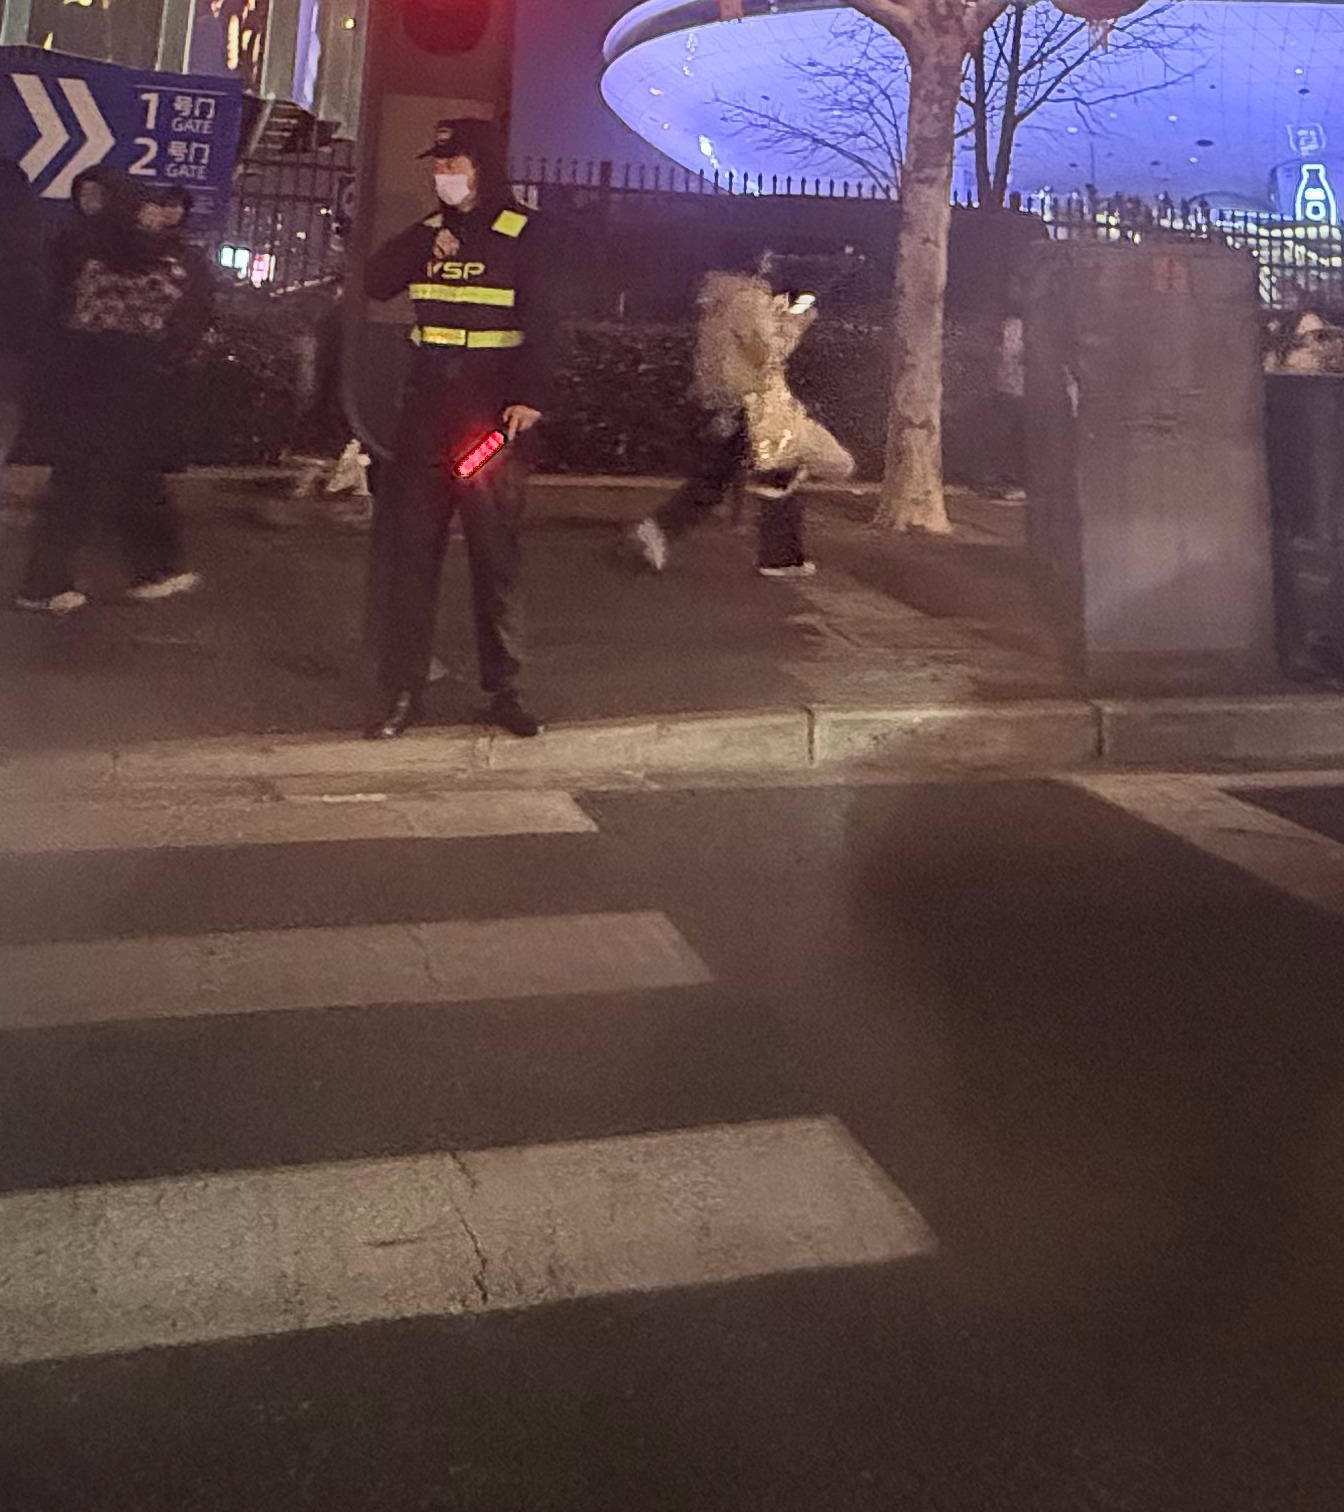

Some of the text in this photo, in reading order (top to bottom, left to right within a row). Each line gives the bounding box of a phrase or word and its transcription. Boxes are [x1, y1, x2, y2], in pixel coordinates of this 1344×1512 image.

[139, 92, 160, 131] 1
[172, 95, 215, 121] 号门
[171, 119, 214, 135] GATE
[127, 137, 159, 176] 2
[167, 140, 211, 166] 号门
[165, 163, 208, 180] GATE
